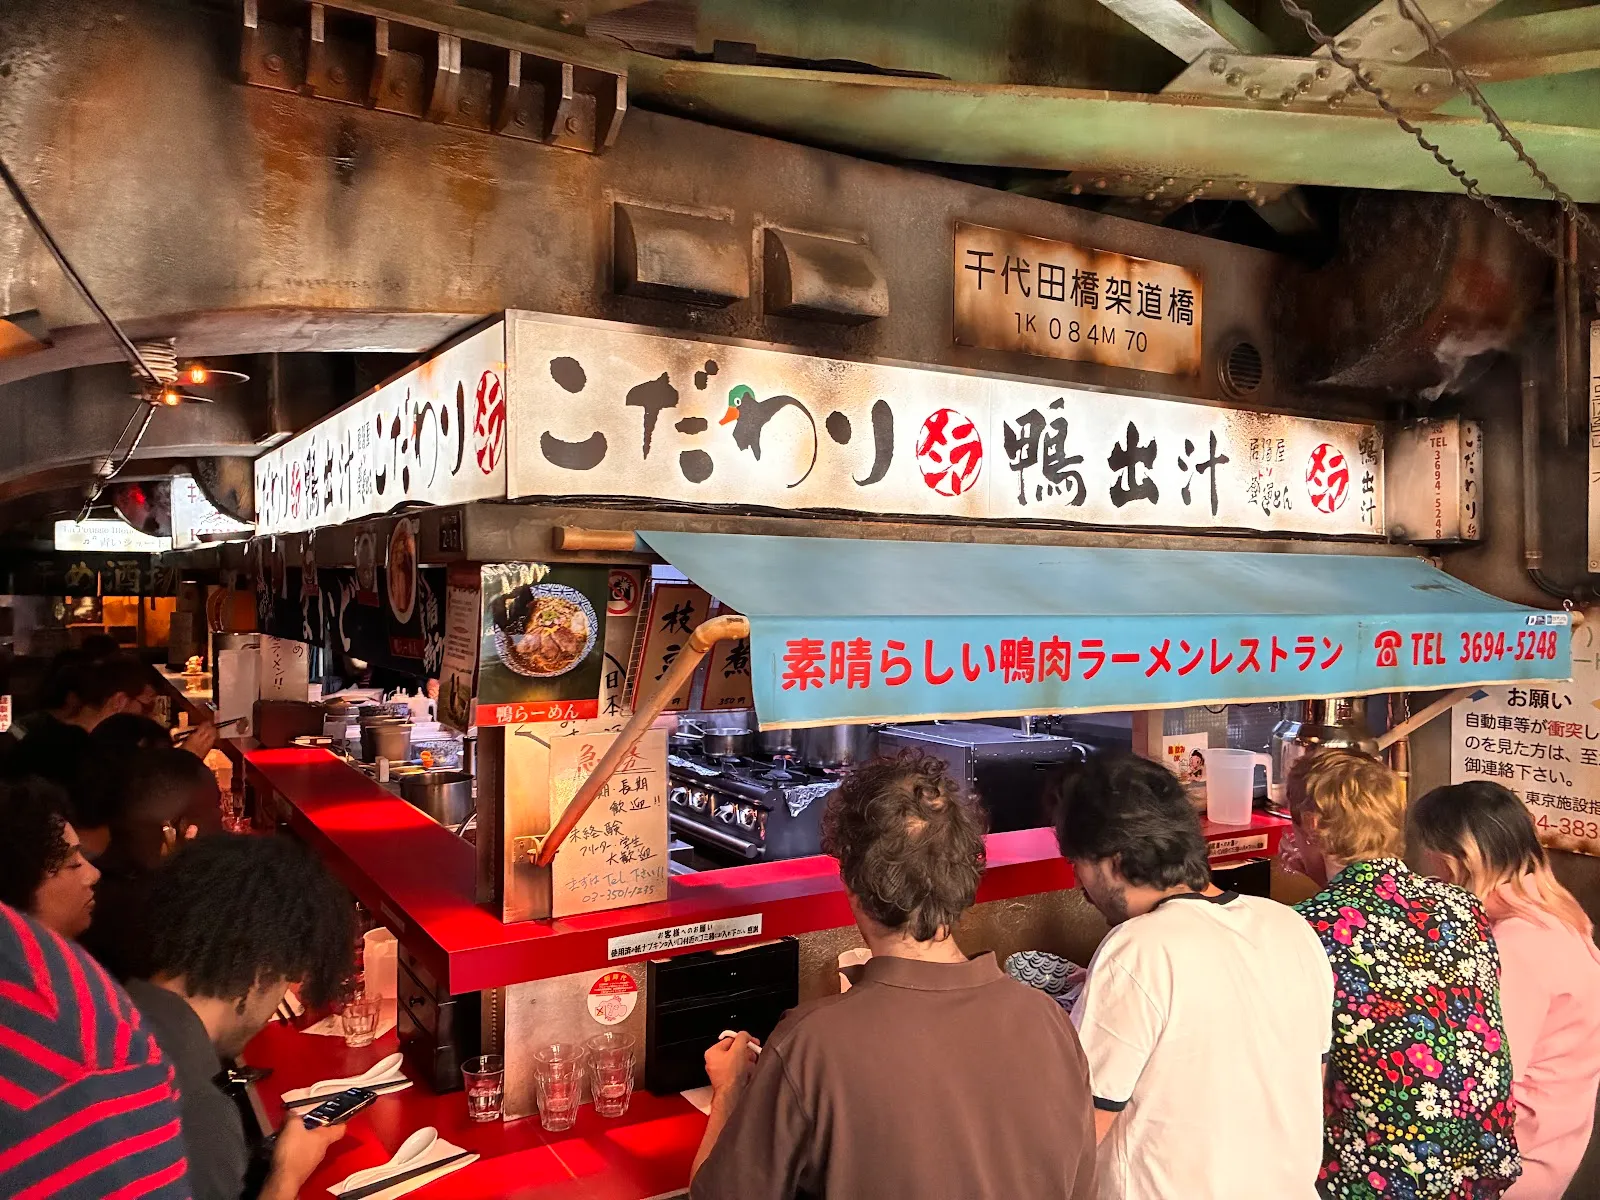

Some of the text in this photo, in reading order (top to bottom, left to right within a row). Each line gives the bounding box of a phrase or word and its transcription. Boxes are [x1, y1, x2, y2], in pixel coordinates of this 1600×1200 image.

[964, 249, 1194, 326] 千代田橋架道橋
[540, 355, 895, 489] こだわり
[1003, 397, 1231, 517] 鴨出汁
[1358, 431, 1379, 526] 鴨出汁
[1430, 437, 1448, 539] TEL 3694-5248
[781, 634, 1343, 692] 素晴らしい鴨肉ラーメンレストラン
[1411, 631, 1447, 666] TEL
[1459, 630, 1558, 665] 3694-5248
[495, 703, 580, 724] 鴨らーめん
[1507, 687, 1573, 710] お願い
[1465, 711, 1600, 741] 自動車等が衝突し
[1464, 756, 1574, 788] 御連絡下さい。
[1465, 735, 1600, 767] のを見た方は、至
[1531, 814, 1600, 840] 4-383
